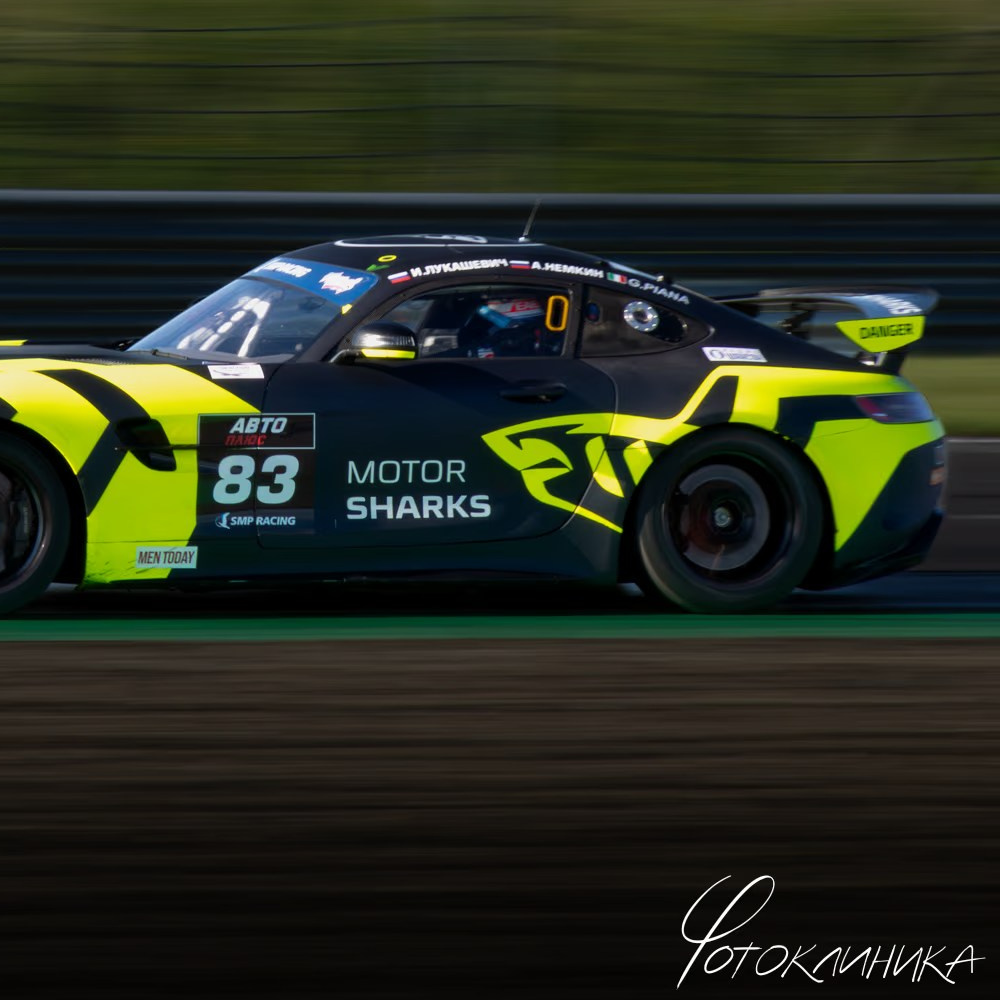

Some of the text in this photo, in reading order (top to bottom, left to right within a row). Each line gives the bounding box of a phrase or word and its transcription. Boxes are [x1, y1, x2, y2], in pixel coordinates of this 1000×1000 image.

[410, 258, 509, 278] И.ЛУКАШЕВИЧ
[531, 261, 604, 278] А.НЕМКИН
[628, 278, 690, 305] G.PIANA
[860, 323, 914, 339] DANGER
[229, 417, 288, 434] АВТО
[225, 434, 267, 446] ПЛЮС
[212, 454, 300, 505] 83
[347, 459, 466, 484] MOTOR
[346, 494, 492, 520] SHARKS
[230, 515, 296, 526] SMP RACING
[137, 550, 195, 565] MEN TODAY
